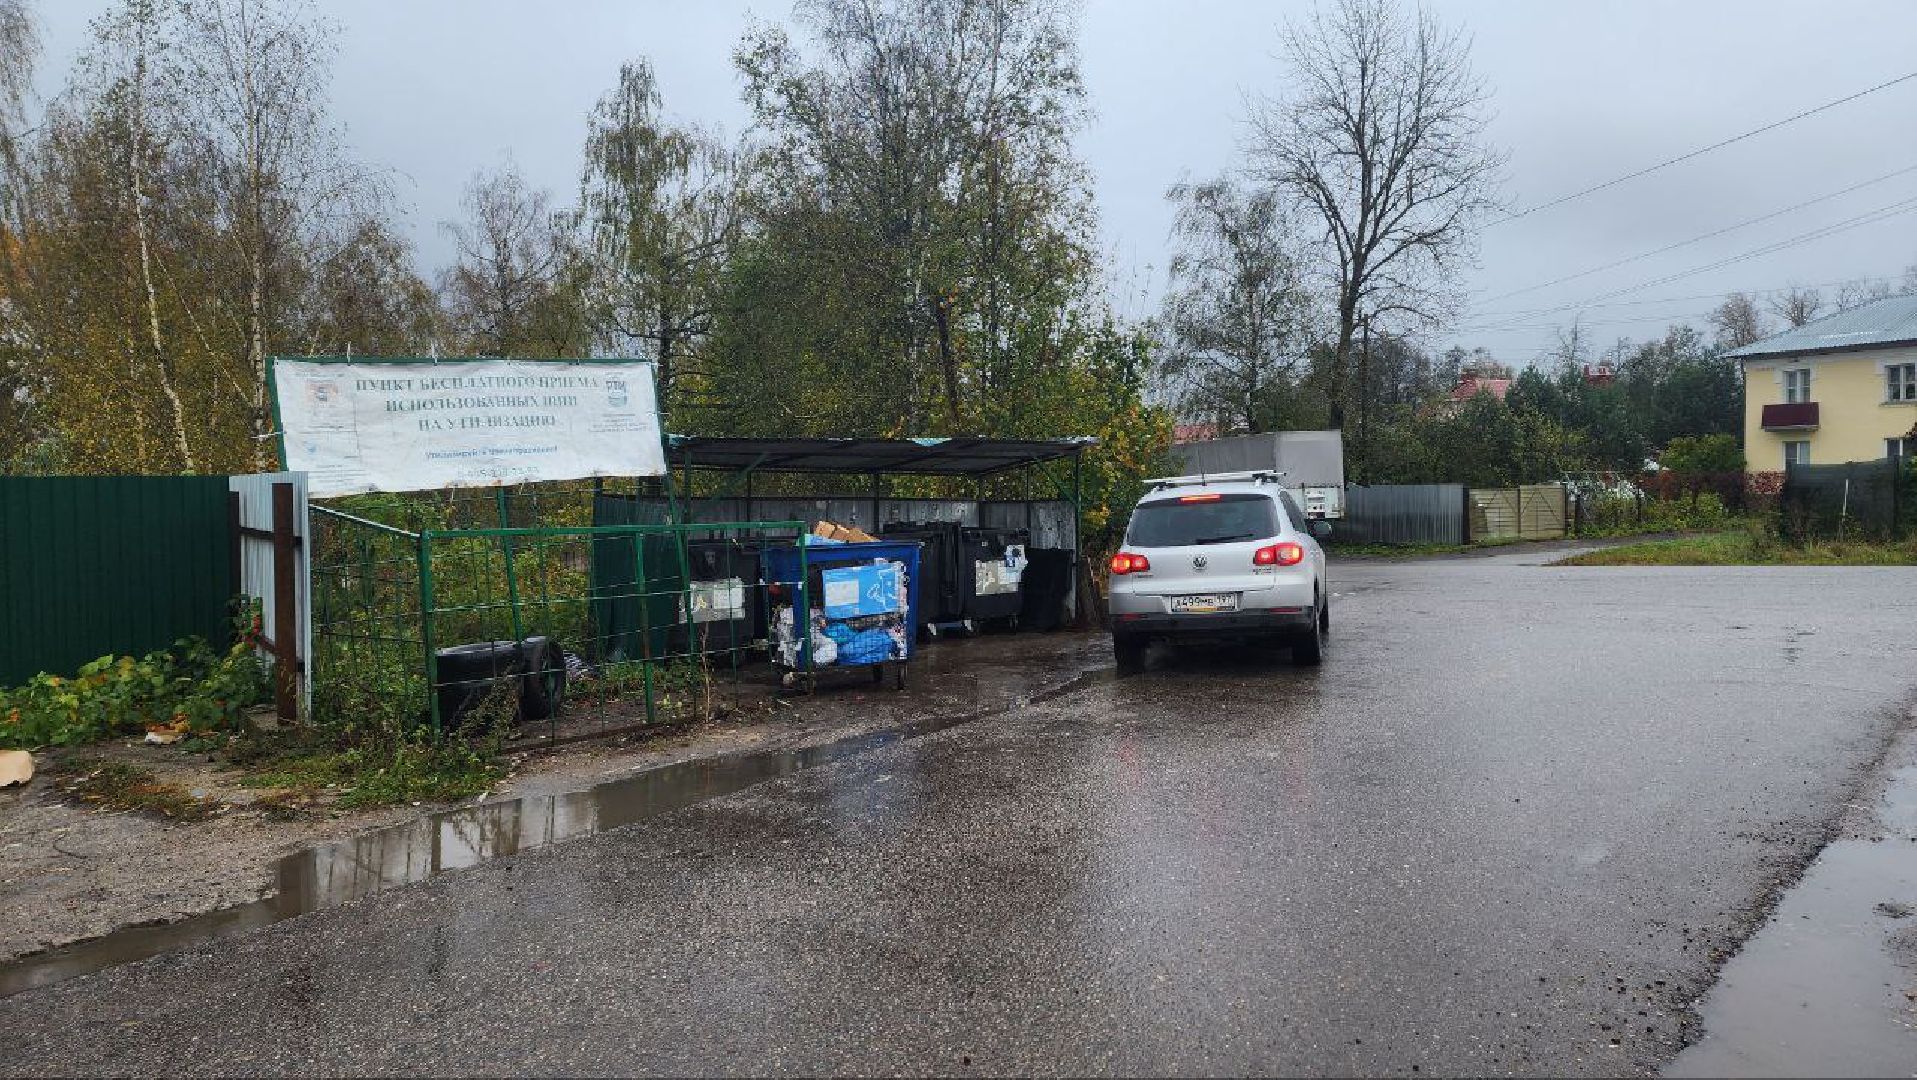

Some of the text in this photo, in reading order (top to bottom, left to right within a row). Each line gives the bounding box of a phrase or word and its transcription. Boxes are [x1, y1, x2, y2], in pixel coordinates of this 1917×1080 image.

[356, 379, 414, 391] ПУНКТ
[420, 376, 536, 391] БЕСПЛАТНОГО
[385, 395, 539, 412] ИСПОЛЬЗОВАННЫХ
[418, 418, 443, 432] НА
